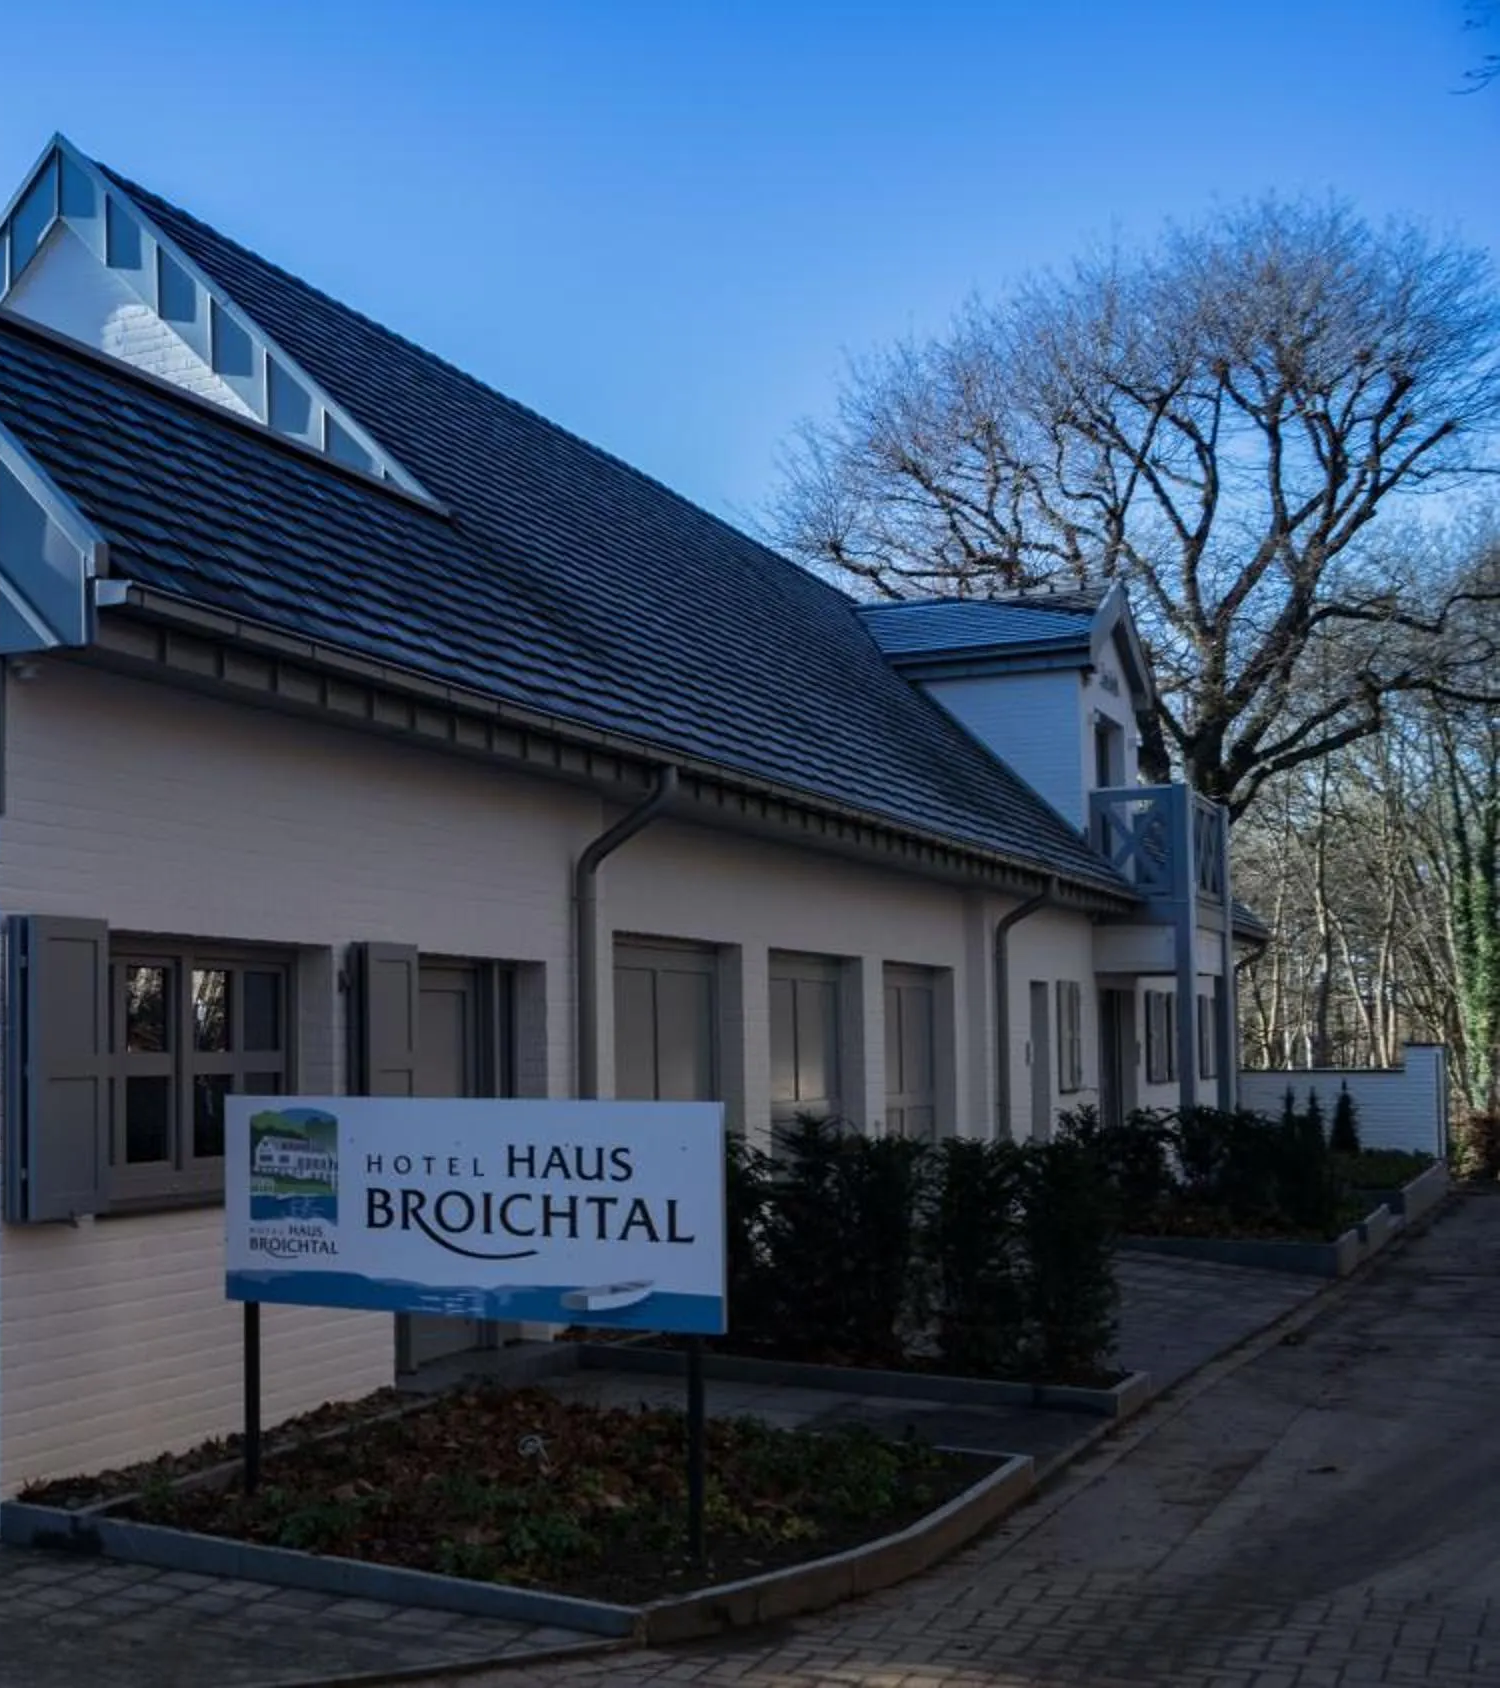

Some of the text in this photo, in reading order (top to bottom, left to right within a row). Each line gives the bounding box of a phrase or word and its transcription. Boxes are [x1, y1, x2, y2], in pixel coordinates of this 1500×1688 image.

[367, 1144, 633, 1181] HOTEL HAUS
[288, 1224, 323, 1237] HAUS
[366, 1187, 695, 1260] BROICHTAL
[249, 1237, 339, 1258] BROICHTAL
